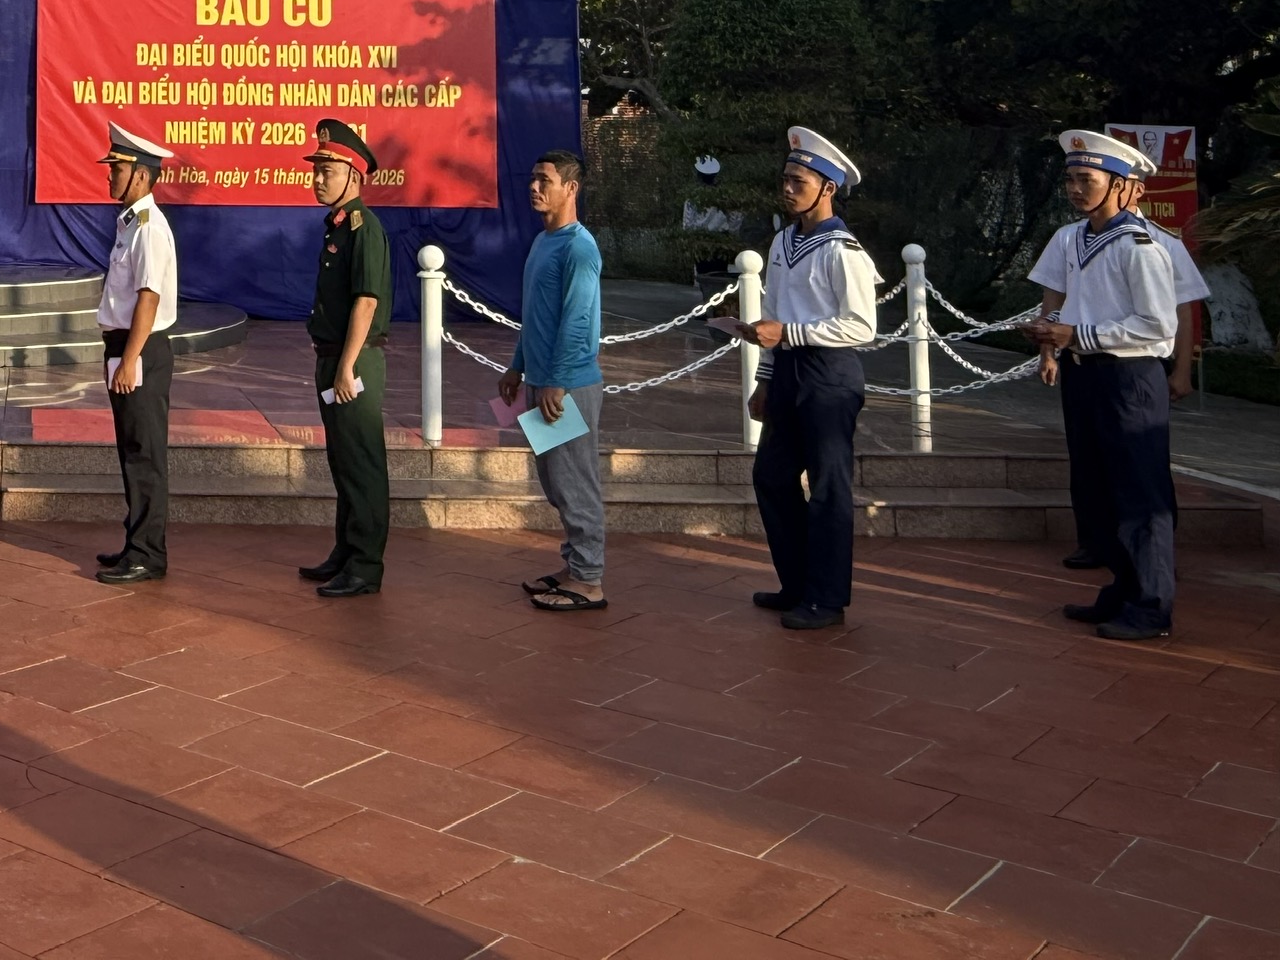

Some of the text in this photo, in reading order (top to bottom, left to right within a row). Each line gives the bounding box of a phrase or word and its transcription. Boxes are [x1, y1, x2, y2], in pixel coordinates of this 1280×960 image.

[136, 35, 397, 72] ĐẠI BIỂU QUỐC HỘI KHÓA XVI
[73, 76, 97, 104] VÀ
[102, 81, 133, 109] ĐẠI
[138, 73, 181, 105] BIỂU
[186, 78, 217, 110] HỘI
[280, 79, 331, 107] NHÂN
[337, 79, 376, 107] DÂN
[381, 79, 418, 107] CÁC
[424, 76, 462, 108] CẤP
[165, 117, 226, 149] NHIỆM
[232, 117, 256, 145] KỲ
[261, 122, 306, 146] 2026
[179, 166, 210, 186] Hòa,
[214, 167, 249, 188] ngày
[254, 168, 270, 185] 15
[273, 168, 314, 189] tháng
[371, 169, 405, 186] 2026
